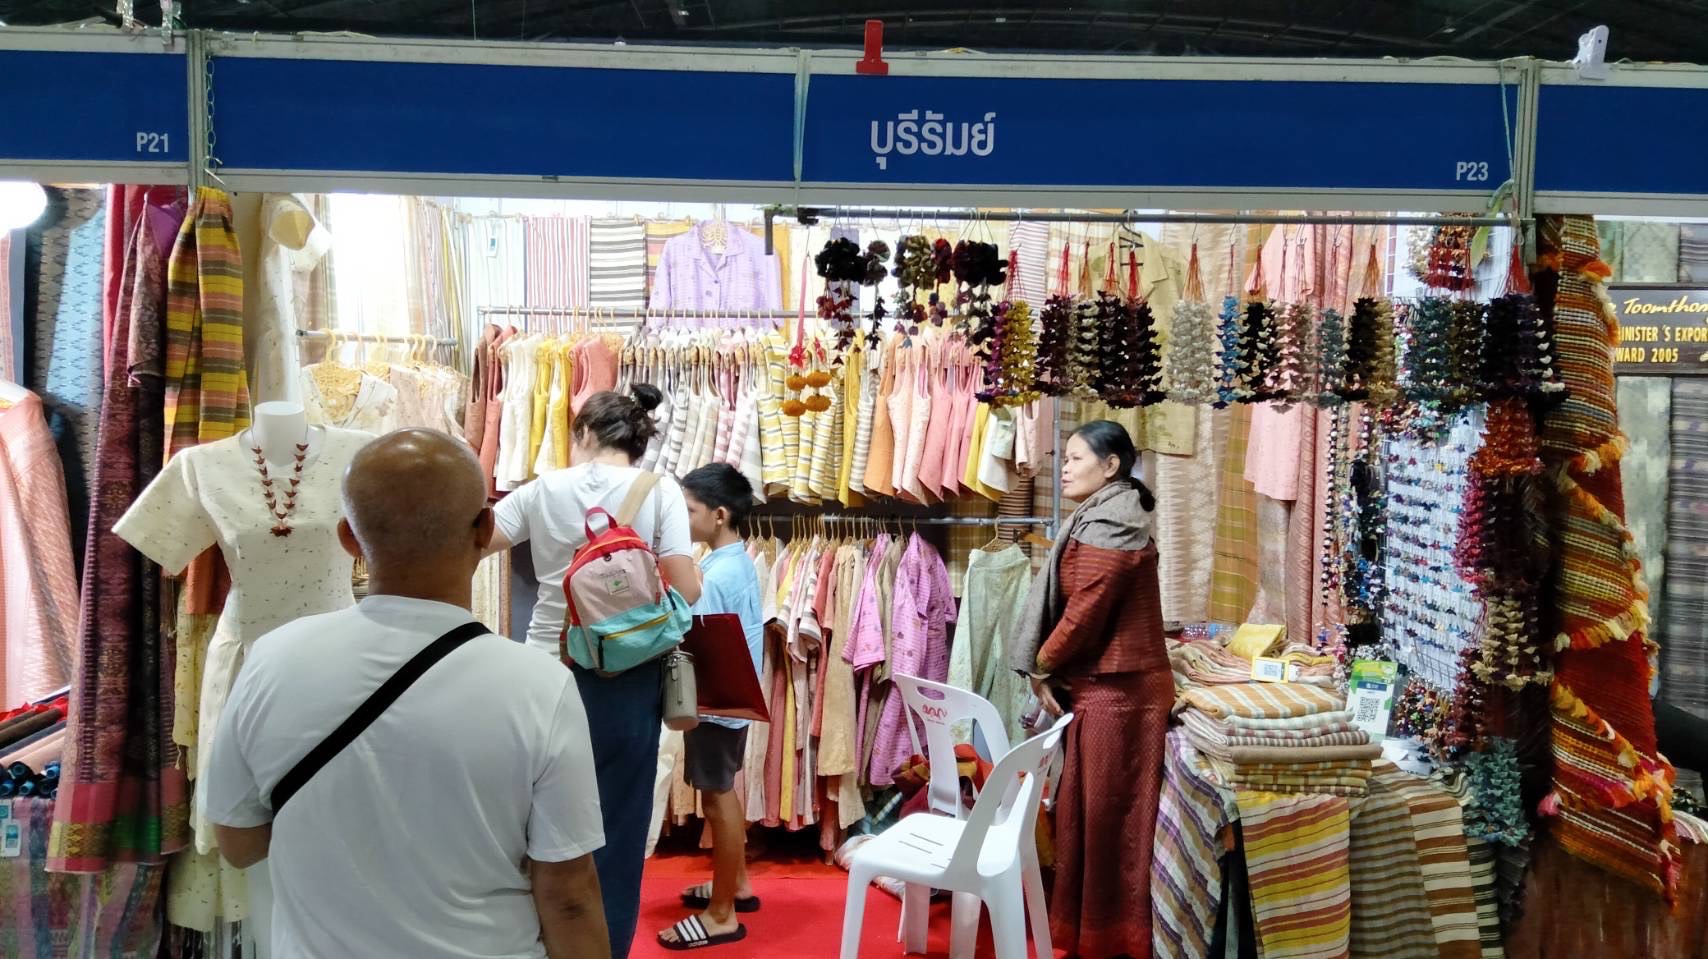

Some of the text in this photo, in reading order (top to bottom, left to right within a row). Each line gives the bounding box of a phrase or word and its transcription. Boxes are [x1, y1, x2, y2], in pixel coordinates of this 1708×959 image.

[136, 132, 169, 153] P21
[870, 109, 996, 170] บุรีรัมย์
[1456, 161, 1489, 181] P23
[1623, 295, 1708, 317] Toomthon
[1621, 326, 1659, 342] INISTER
[1675, 327, 1708, 342] EXPOR
[1616, 347, 1679, 363] WARD 2005
